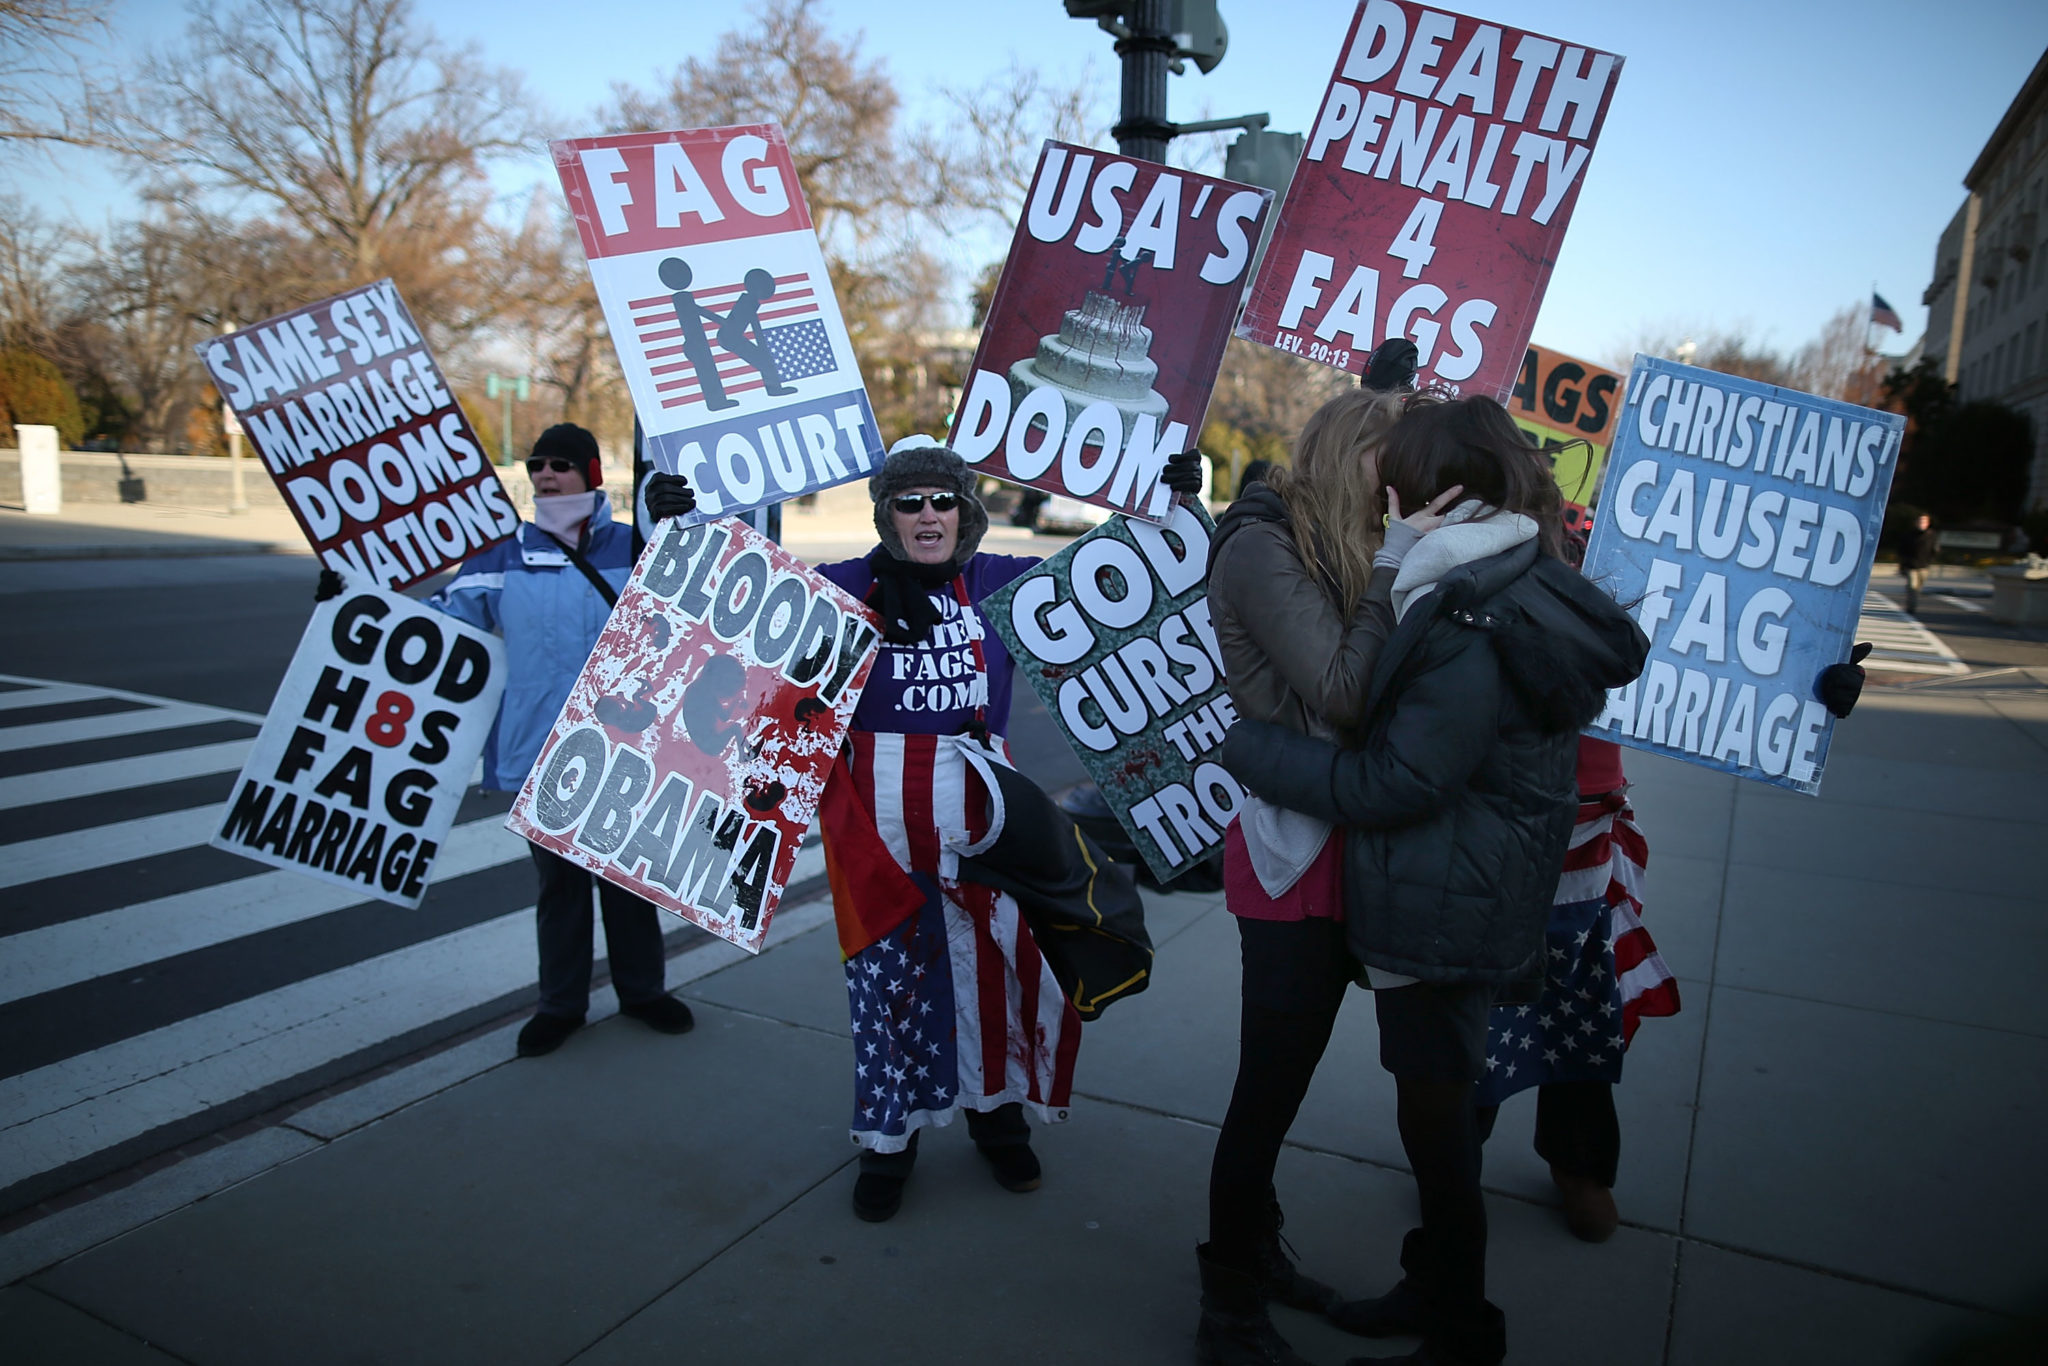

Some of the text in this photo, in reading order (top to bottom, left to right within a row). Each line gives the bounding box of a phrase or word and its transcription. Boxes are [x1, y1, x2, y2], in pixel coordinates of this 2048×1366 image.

[1341, 0, 1615, 140] DEATH
[579, 135, 790, 237] FAG
[1307, 81, 1591, 226] PENALTY
[1028, 148, 1264, 285] USA'S
[1387, 197, 1445, 279] 4
[207, 283, 420, 411] SAME-SEX
[1274, 331, 1304, 354] LEV.
[1310, 342, 1350, 368] 20:13
[1277, 249, 1498, 381] FAGS
[248, 351, 452, 475] MARRIAGE
[952, 369, 1188, 517] DOOM
[1512, 348, 1620, 434] AGS
[1629, 371, 1898, 497] 'CHRISTIANS'
[286, 413, 482, 542] DOOMS
[677, 404, 873, 515] COURT
[322, 476, 518, 592] NATIONS
[1012, 504, 1211, 665] GOD
[1615, 460, 1862, 587] CAUSED
[332, 594, 490, 703] GOD
[642, 522, 880, 704] BLOODY
[892, 647, 977, 681] FAGS
[1638, 558, 1794, 676] FAG
[274, 725, 439, 827] FAG
[303, 665, 461, 765] H8S
[1592, 659, 1827, 783] ARRIAGE
[220, 779, 438, 899] MARRIAGE
[537, 728, 779, 931] OBAMA
[1129, 762, 1250, 868] TRO
